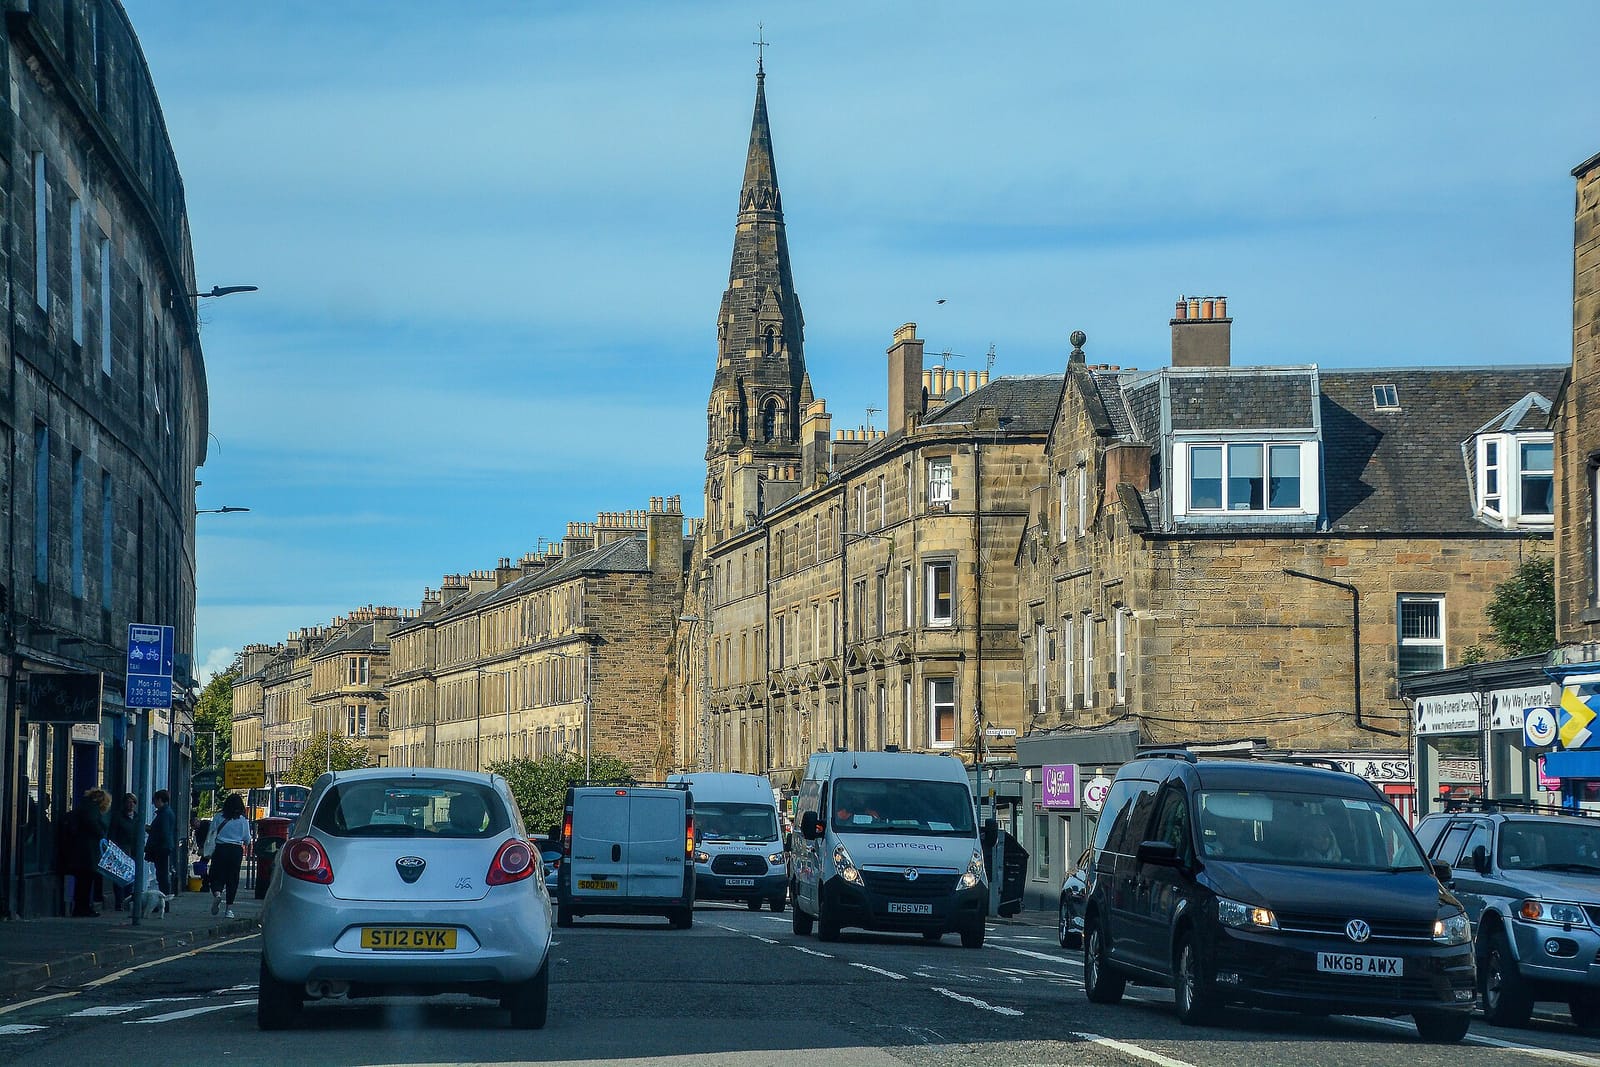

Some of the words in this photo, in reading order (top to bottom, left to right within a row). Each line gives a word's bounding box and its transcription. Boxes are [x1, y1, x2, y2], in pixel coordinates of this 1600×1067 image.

[1444, 698, 1460, 713] Funeral
[1502, 695, 1511, 710] My
[1512, 694, 1524, 708] Way
[1524, 691, 1542, 706] Funeral
[868, 842, 944, 852] openreach
[914, 904, 928, 913] VPR
[372, 930, 408, 946] ST12
[413, 930, 446, 946] GYK
[1324, 955, 1363, 971] NK68
[1368, 958, 1396, 974] AWX
